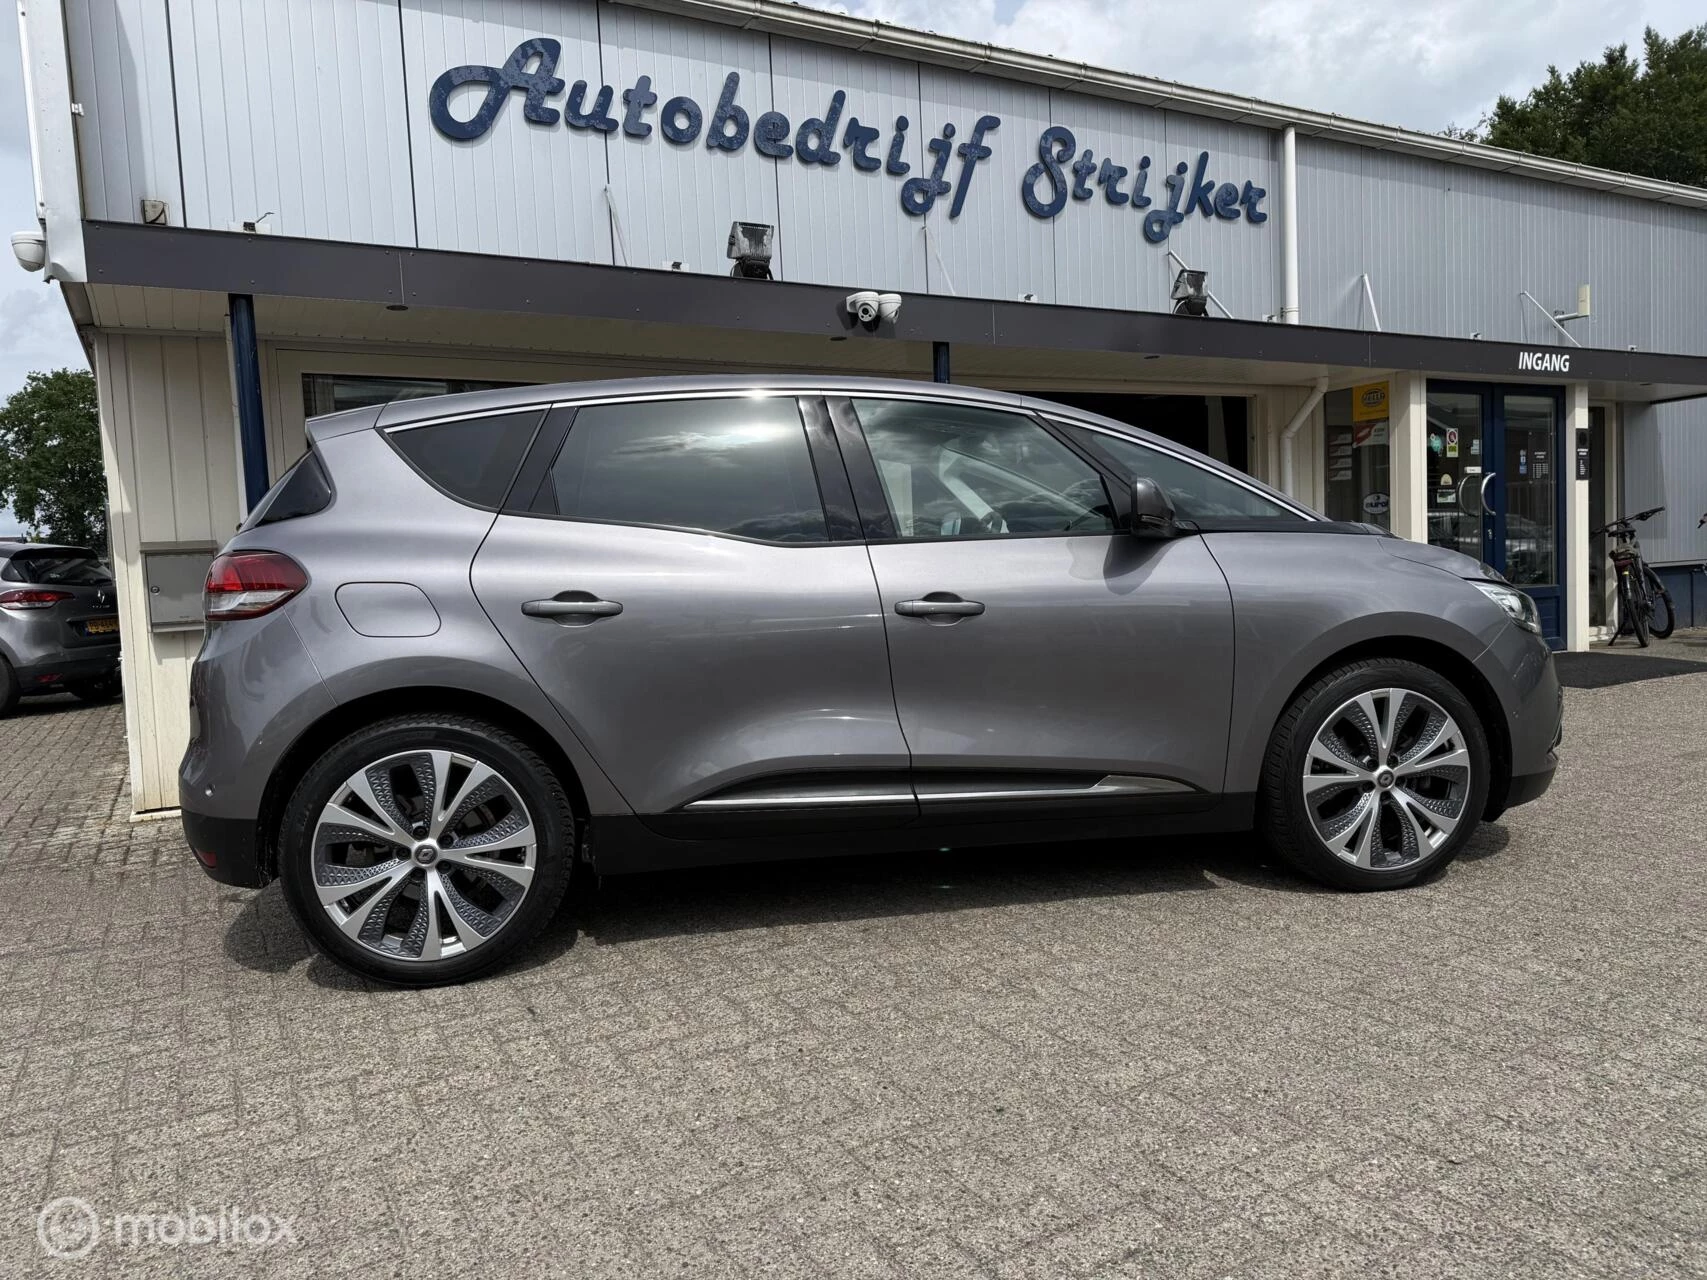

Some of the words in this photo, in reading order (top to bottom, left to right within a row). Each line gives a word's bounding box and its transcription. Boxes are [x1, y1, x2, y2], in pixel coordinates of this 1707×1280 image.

[430, 38, 1001, 218] Autobedrijf
[1022, 125, 1268, 243] Strijker
[1518, 351, 1570, 372] INGANG
